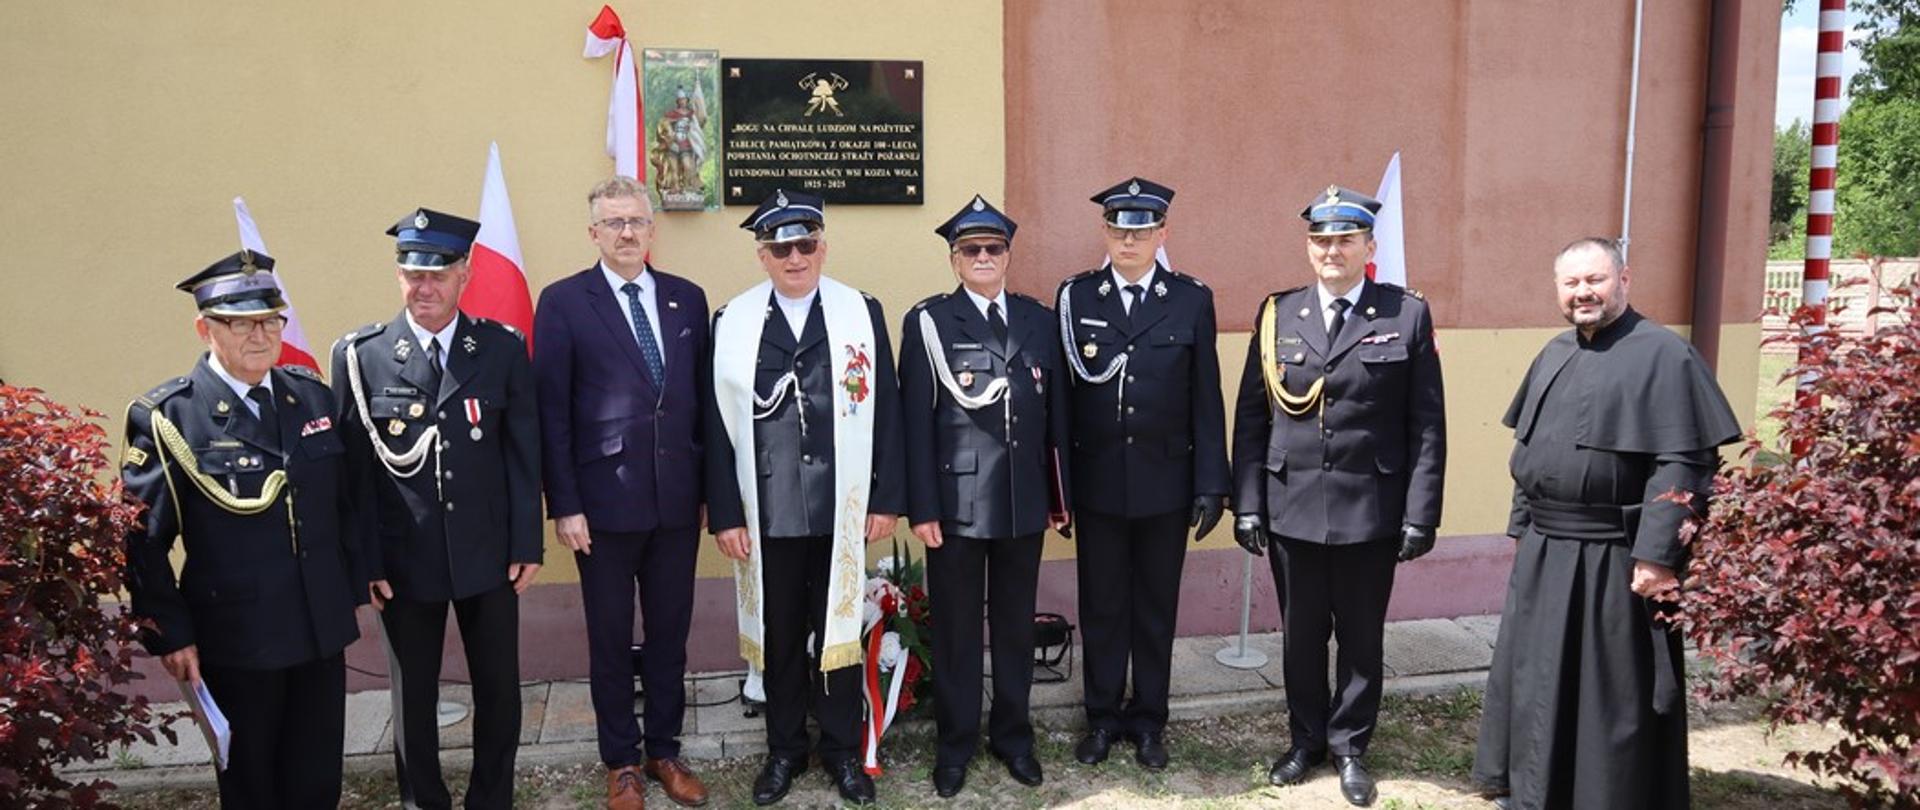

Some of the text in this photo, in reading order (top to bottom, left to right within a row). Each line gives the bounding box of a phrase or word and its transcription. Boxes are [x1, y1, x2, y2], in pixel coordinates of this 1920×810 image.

[762, 124, 776, 133] NA
[816, 124, 857, 133] LUDZIOM
[859, 124, 871, 133] NA
[830, 140, 837, 149] Z
[839, 140, 871, 149] OKAZJI
[727, 152, 777, 161] POWSTANIA
[778, 152, 839, 161] OCHOTNICZEJ
[841, 151, 875, 161] STRAŻY
[728, 168, 785, 177] UFUNDOWALI
[845, 168, 862, 177] WSI
[864, 168, 891, 177] KOZIA
[893, 168, 919, 177] WOLA
[827, 180, 846, 189] 2025
